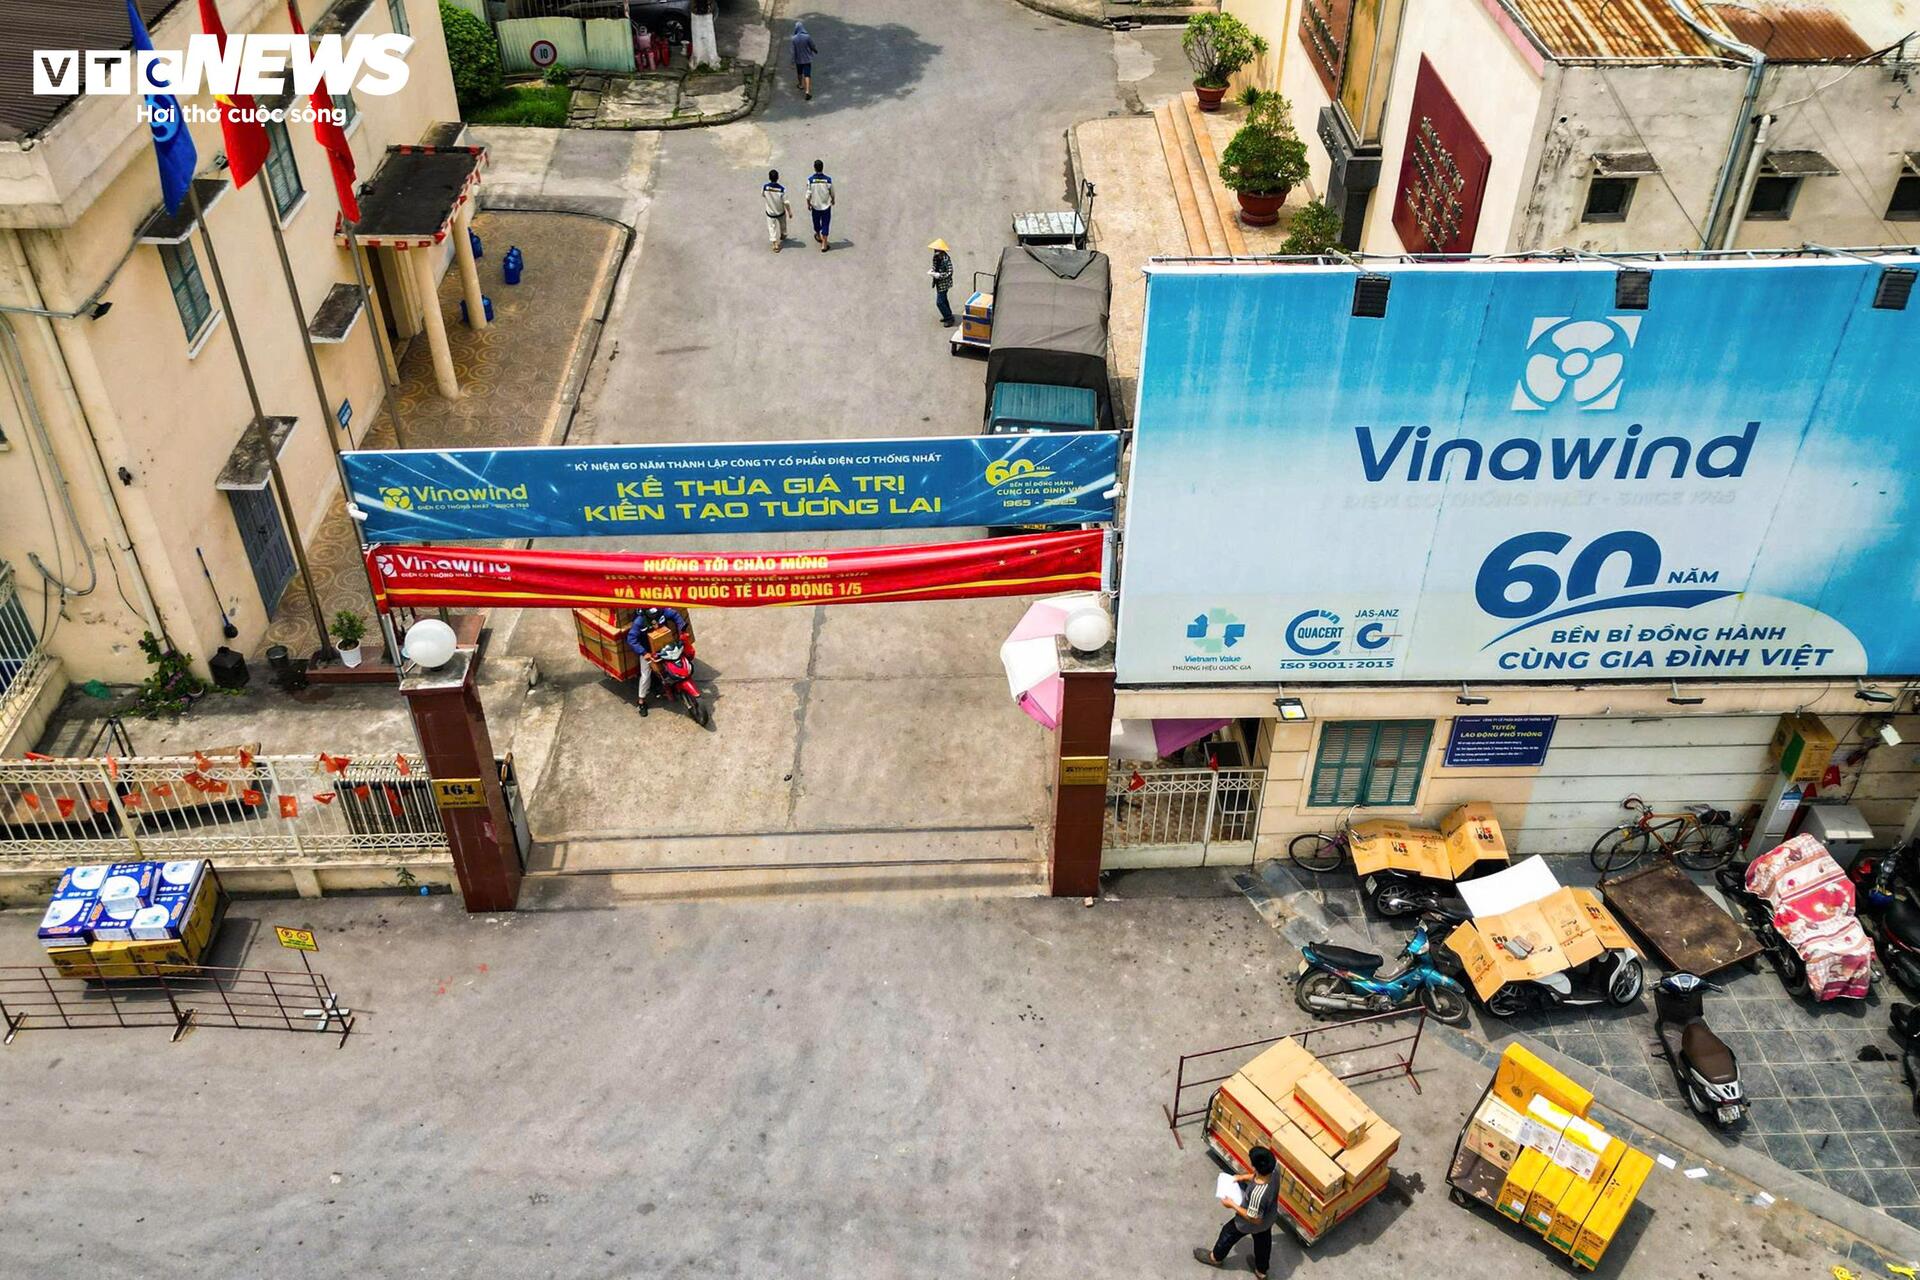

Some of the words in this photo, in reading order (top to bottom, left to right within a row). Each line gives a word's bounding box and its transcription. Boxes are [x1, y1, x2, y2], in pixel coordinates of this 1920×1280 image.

[540, 48, 549, 60] 10
[1354, 421, 1762, 482] Vinawind
[591, 461, 620, 472] NIỆM
[622, 462, 638, 470] 60
[640, 460, 666, 470] NĂM
[668, 459, 705, 469] THÀNH
[707, 458, 728, 470] LẬP
[730, 457, 761, 467] CÔNG
[762, 458, 776, 467] TY
[828, 454, 854, 466] ĐIỆN
[855, 455, 871, 465] CƠ
[872, 453, 910, 464] THỐNG
[912, 451, 942, 463] NHẤT
[985, 458, 1035, 486] 60
[412, 483, 528, 502] Vinawind
[616, 474, 664, 498] KẾ
[674, 475, 772, 497] THỪA
[783, 473, 841, 494] GIÁ
[852, 475, 905, 495] TRỊ
[583, 498, 665, 522] KIẾN
[675, 502, 749, 522] TẠO
[760, 497, 879, 517] TƯƠNG
[889, 497, 942, 514] LAI
[1003, 499, 1032, 508] 1965
[703, 556, 729, 572] TỚI
[732, 555, 776, 571] CHÀO
[780, 554, 829, 570] MỪNG
[1474, 530, 1662, 619] 60
[1667, 566, 1720, 584] NĂM
[614, 585, 635, 598] VÀ
[640, 584, 683, 600] NGÀY
[687, 582, 730, 600] QUỐC
[734, 582, 752, 598] TẾ
[757, 584, 786, 597] LAO
[790, 581, 833, 599] ĐỘNG
[838, 582, 862, 596] 1/5
[1355, 608, 1400, 618] JAS-ANZ
[1297, 626, 1344, 639] QUACERT
[1550, 624, 1600, 643] BỀN
[1606, 624, 1634, 643] BỈ
[1637, 624, 1710, 642] ĐỒNG
[1716, 624, 1787, 641] HÀNH
[1184, 655, 1218, 663] Vietnam
[1219, 655, 1242, 663] Value
[1280, 662, 1305, 670] ISO
[1499, 646, 1589, 670] CÙNG
[1599, 650, 1655, 669] GIA
[1665, 644, 1745, 668] ĐÌNH
[1756, 643, 1835, 671] VIỆT
[1476, 731, 1499, 739] ĐỘNG
[442, 784, 475, 796] 164
